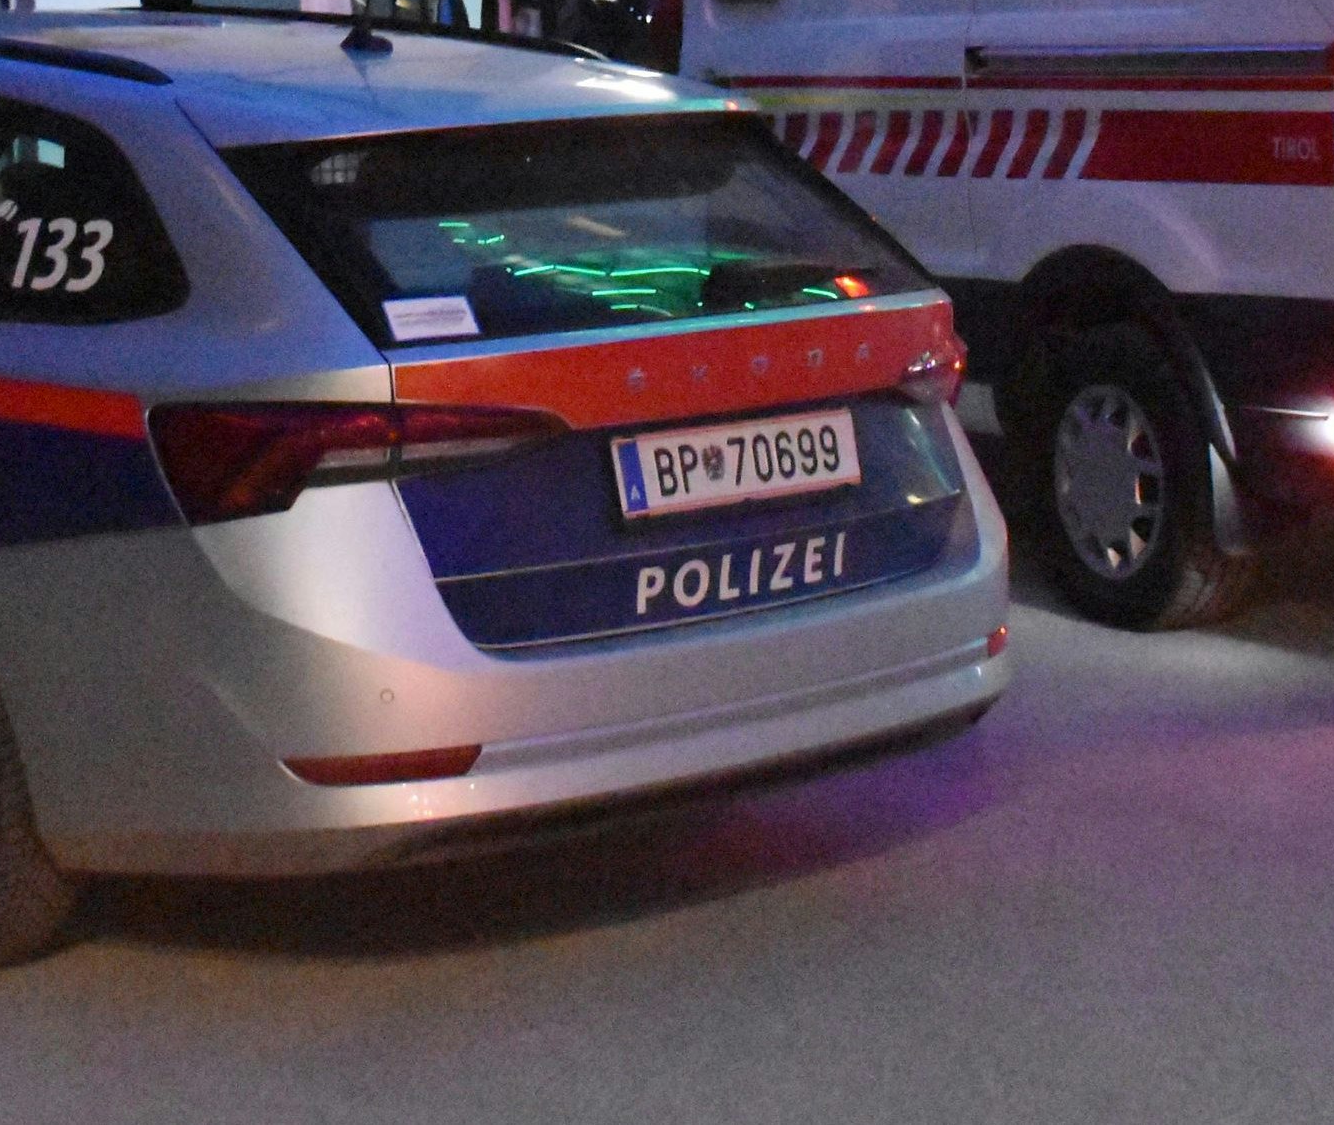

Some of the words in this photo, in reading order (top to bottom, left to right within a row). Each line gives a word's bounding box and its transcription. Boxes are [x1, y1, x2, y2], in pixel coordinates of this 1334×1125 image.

[1271, 135, 1322, 161] TIROL
[11, 217, 114, 292] 133
[653, 444, 698, 498] BP
[726, 424, 841, 487] 70699
[636, 531, 846, 615] POLIZEI
